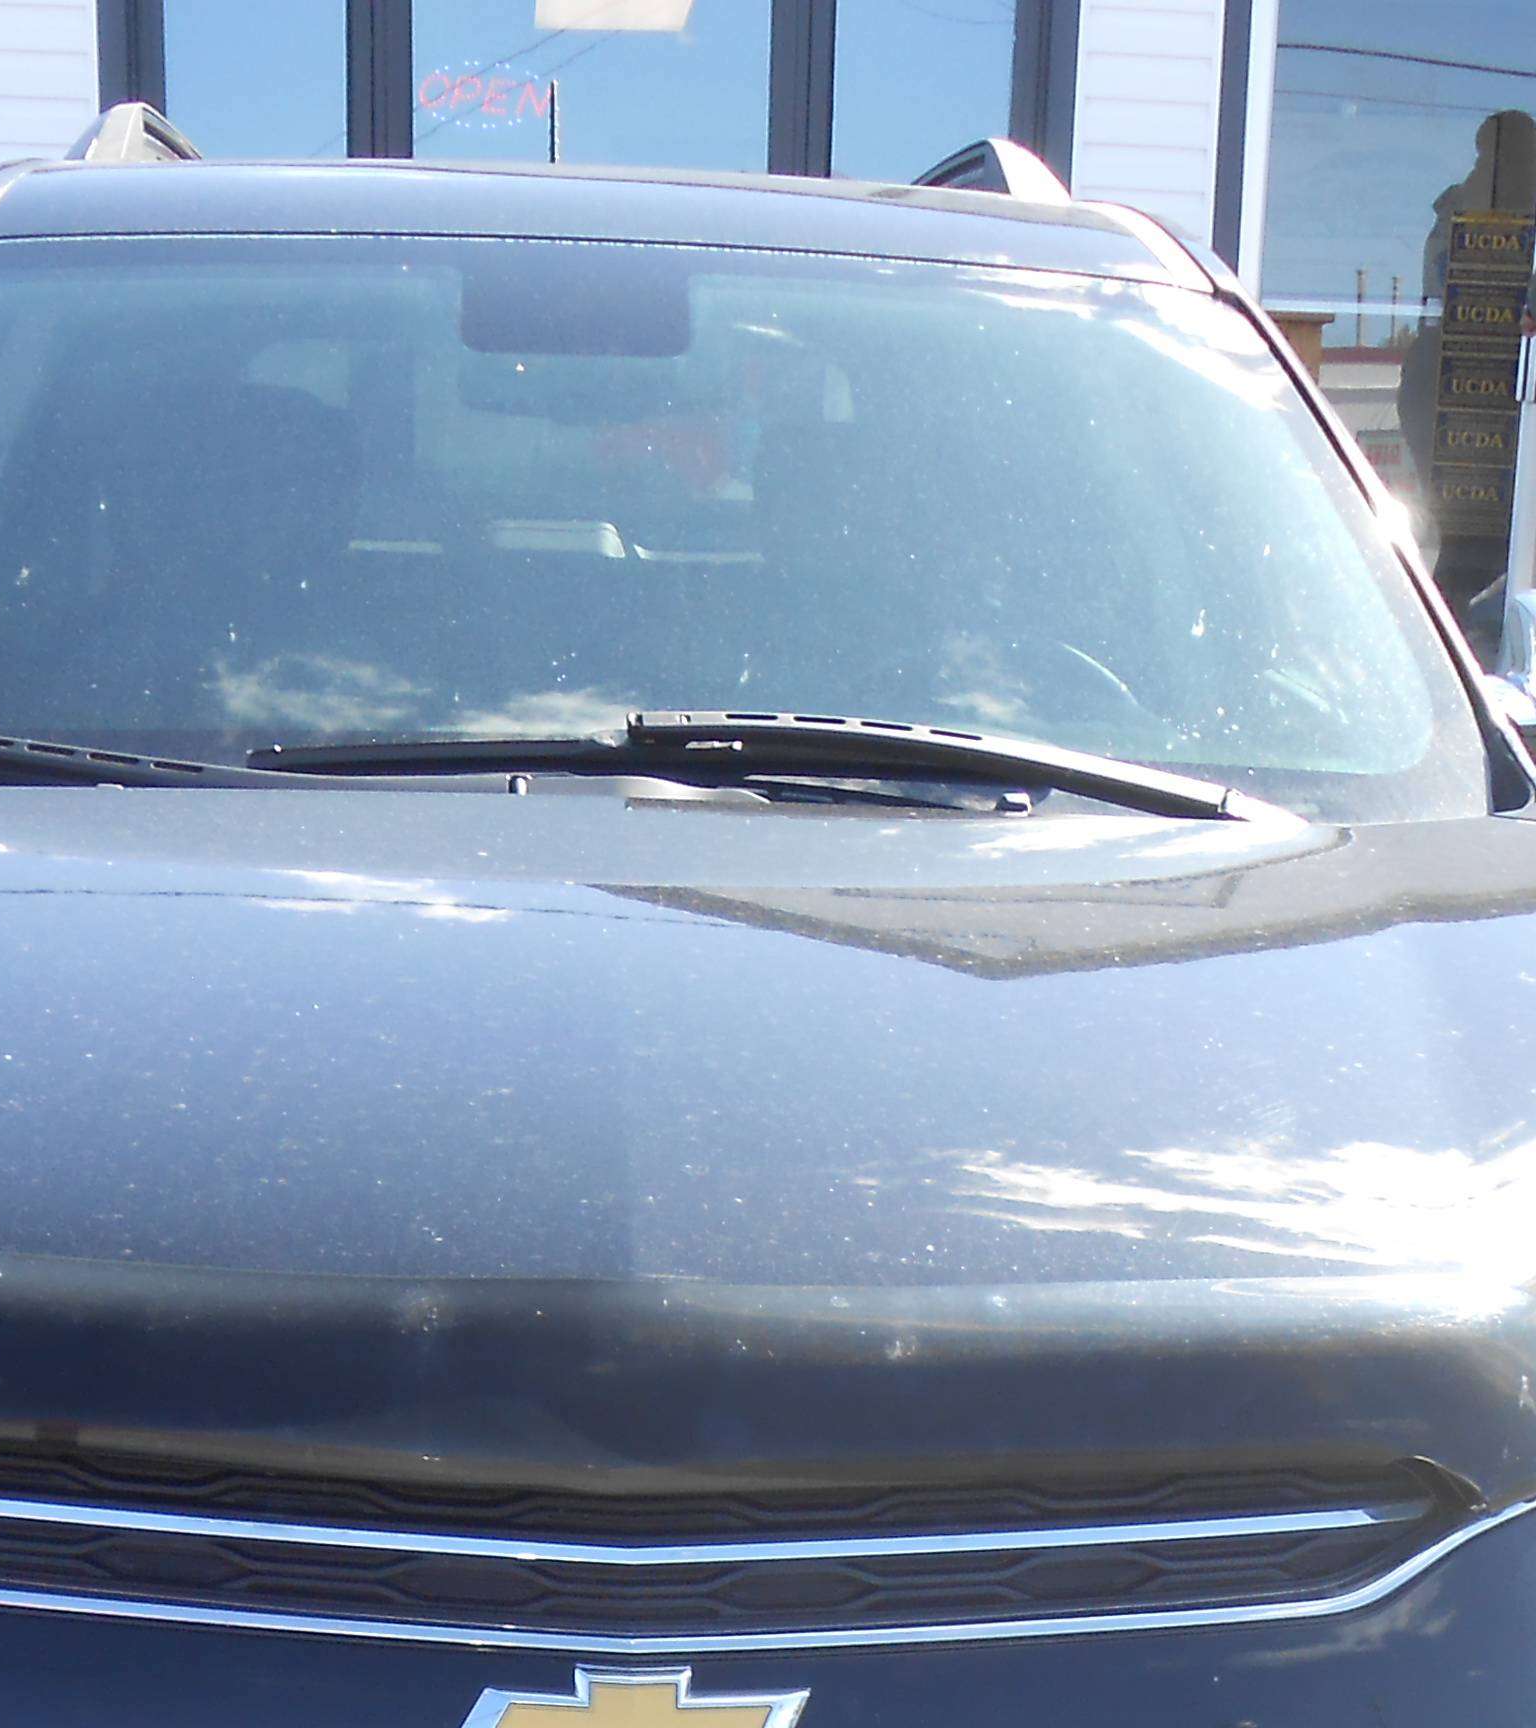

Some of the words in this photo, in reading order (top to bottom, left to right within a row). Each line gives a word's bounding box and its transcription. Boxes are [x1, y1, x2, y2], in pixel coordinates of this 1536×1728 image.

[418, 73, 553, 117] OPEN
[1464, 232, 1521, 250] UCDA
[1457, 304, 1514, 322] UCDA
[1452, 377, 1509, 397] UCDA
[1447, 430, 1504, 449] UCDA
[1442, 483, 1500, 502] UCDA
